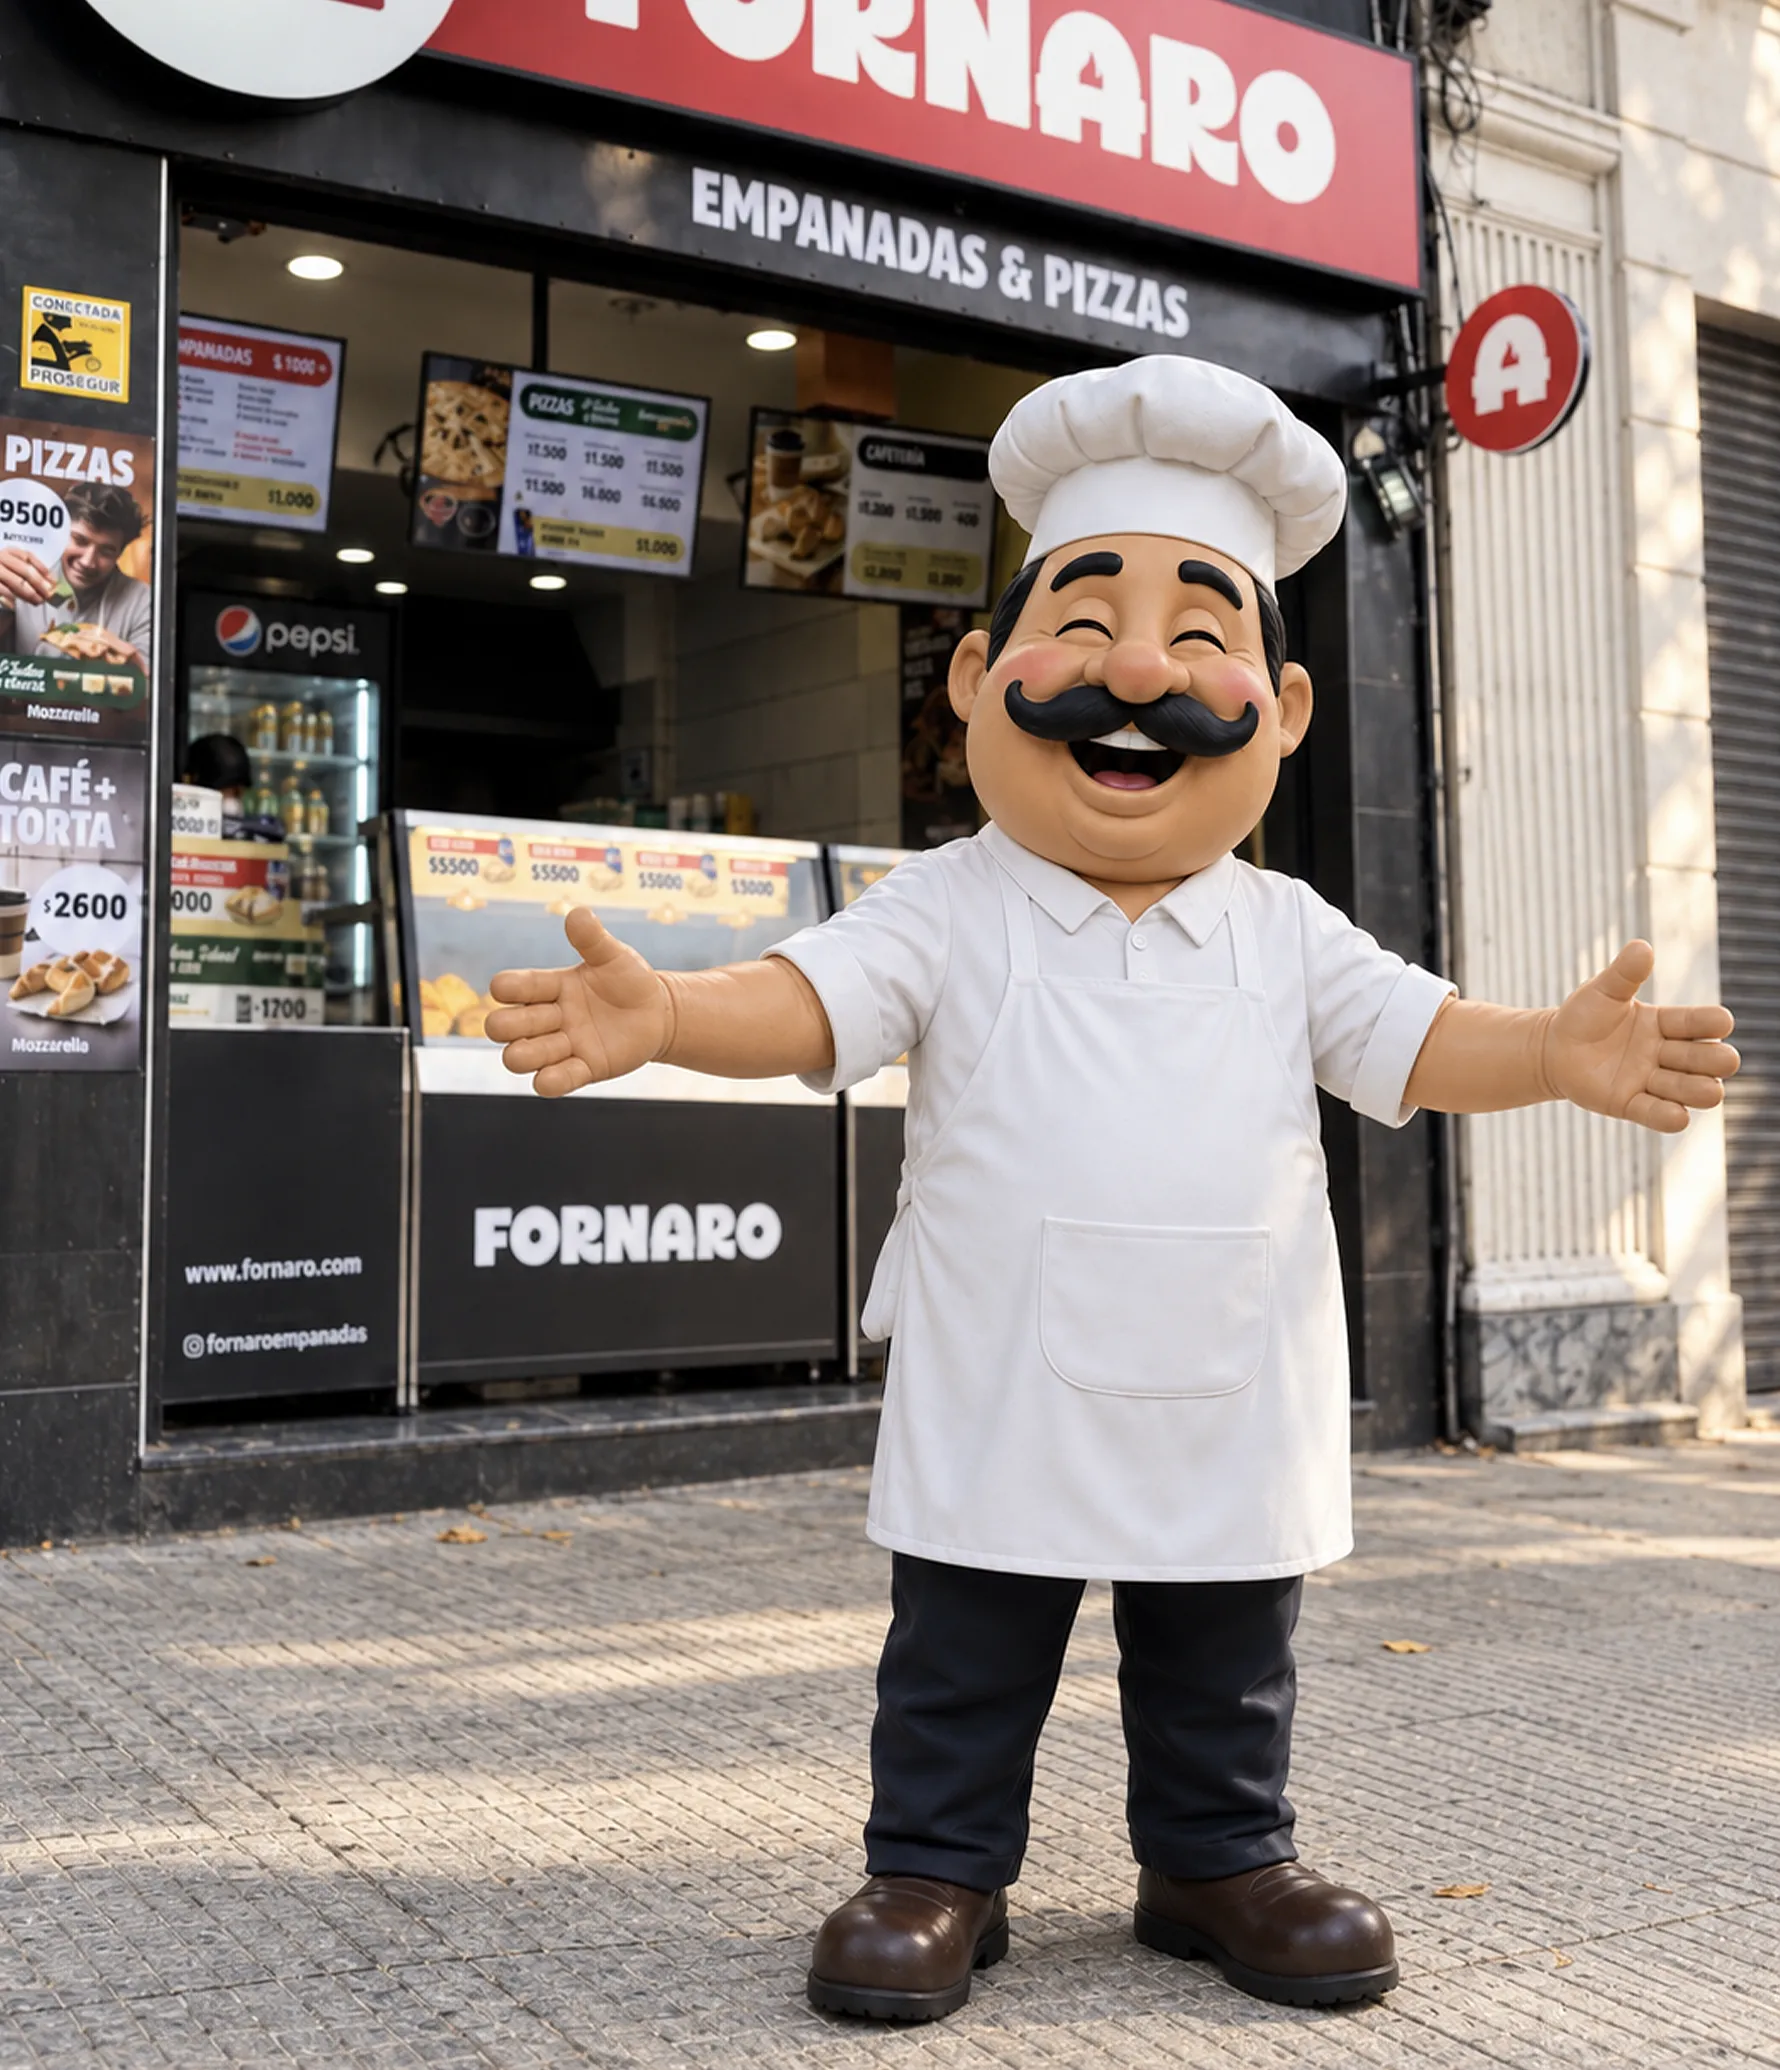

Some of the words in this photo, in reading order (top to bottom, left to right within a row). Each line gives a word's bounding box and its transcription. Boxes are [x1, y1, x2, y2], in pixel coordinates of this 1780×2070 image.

[692, 167, 988, 290] EMPANADAS
[999, 245, 1032, 301] &
[1044, 253, 1190, 339] PIZZAS
[32, 295, 121, 321] CONECTADA
[30, 368, 120, 393] PROSEGUR
[1471, 313, 1551, 416] A
[5, 434, 135, 487] PIZZAS
[0, 499, 64, 529] 9500
[0, 803, 116, 849] TORTA
[12, 1036, 89, 1054] Mozzarella
[474, 1203, 782, 1267] FORNARO
[185, 1256, 362, 1284] www.fornaro.com
